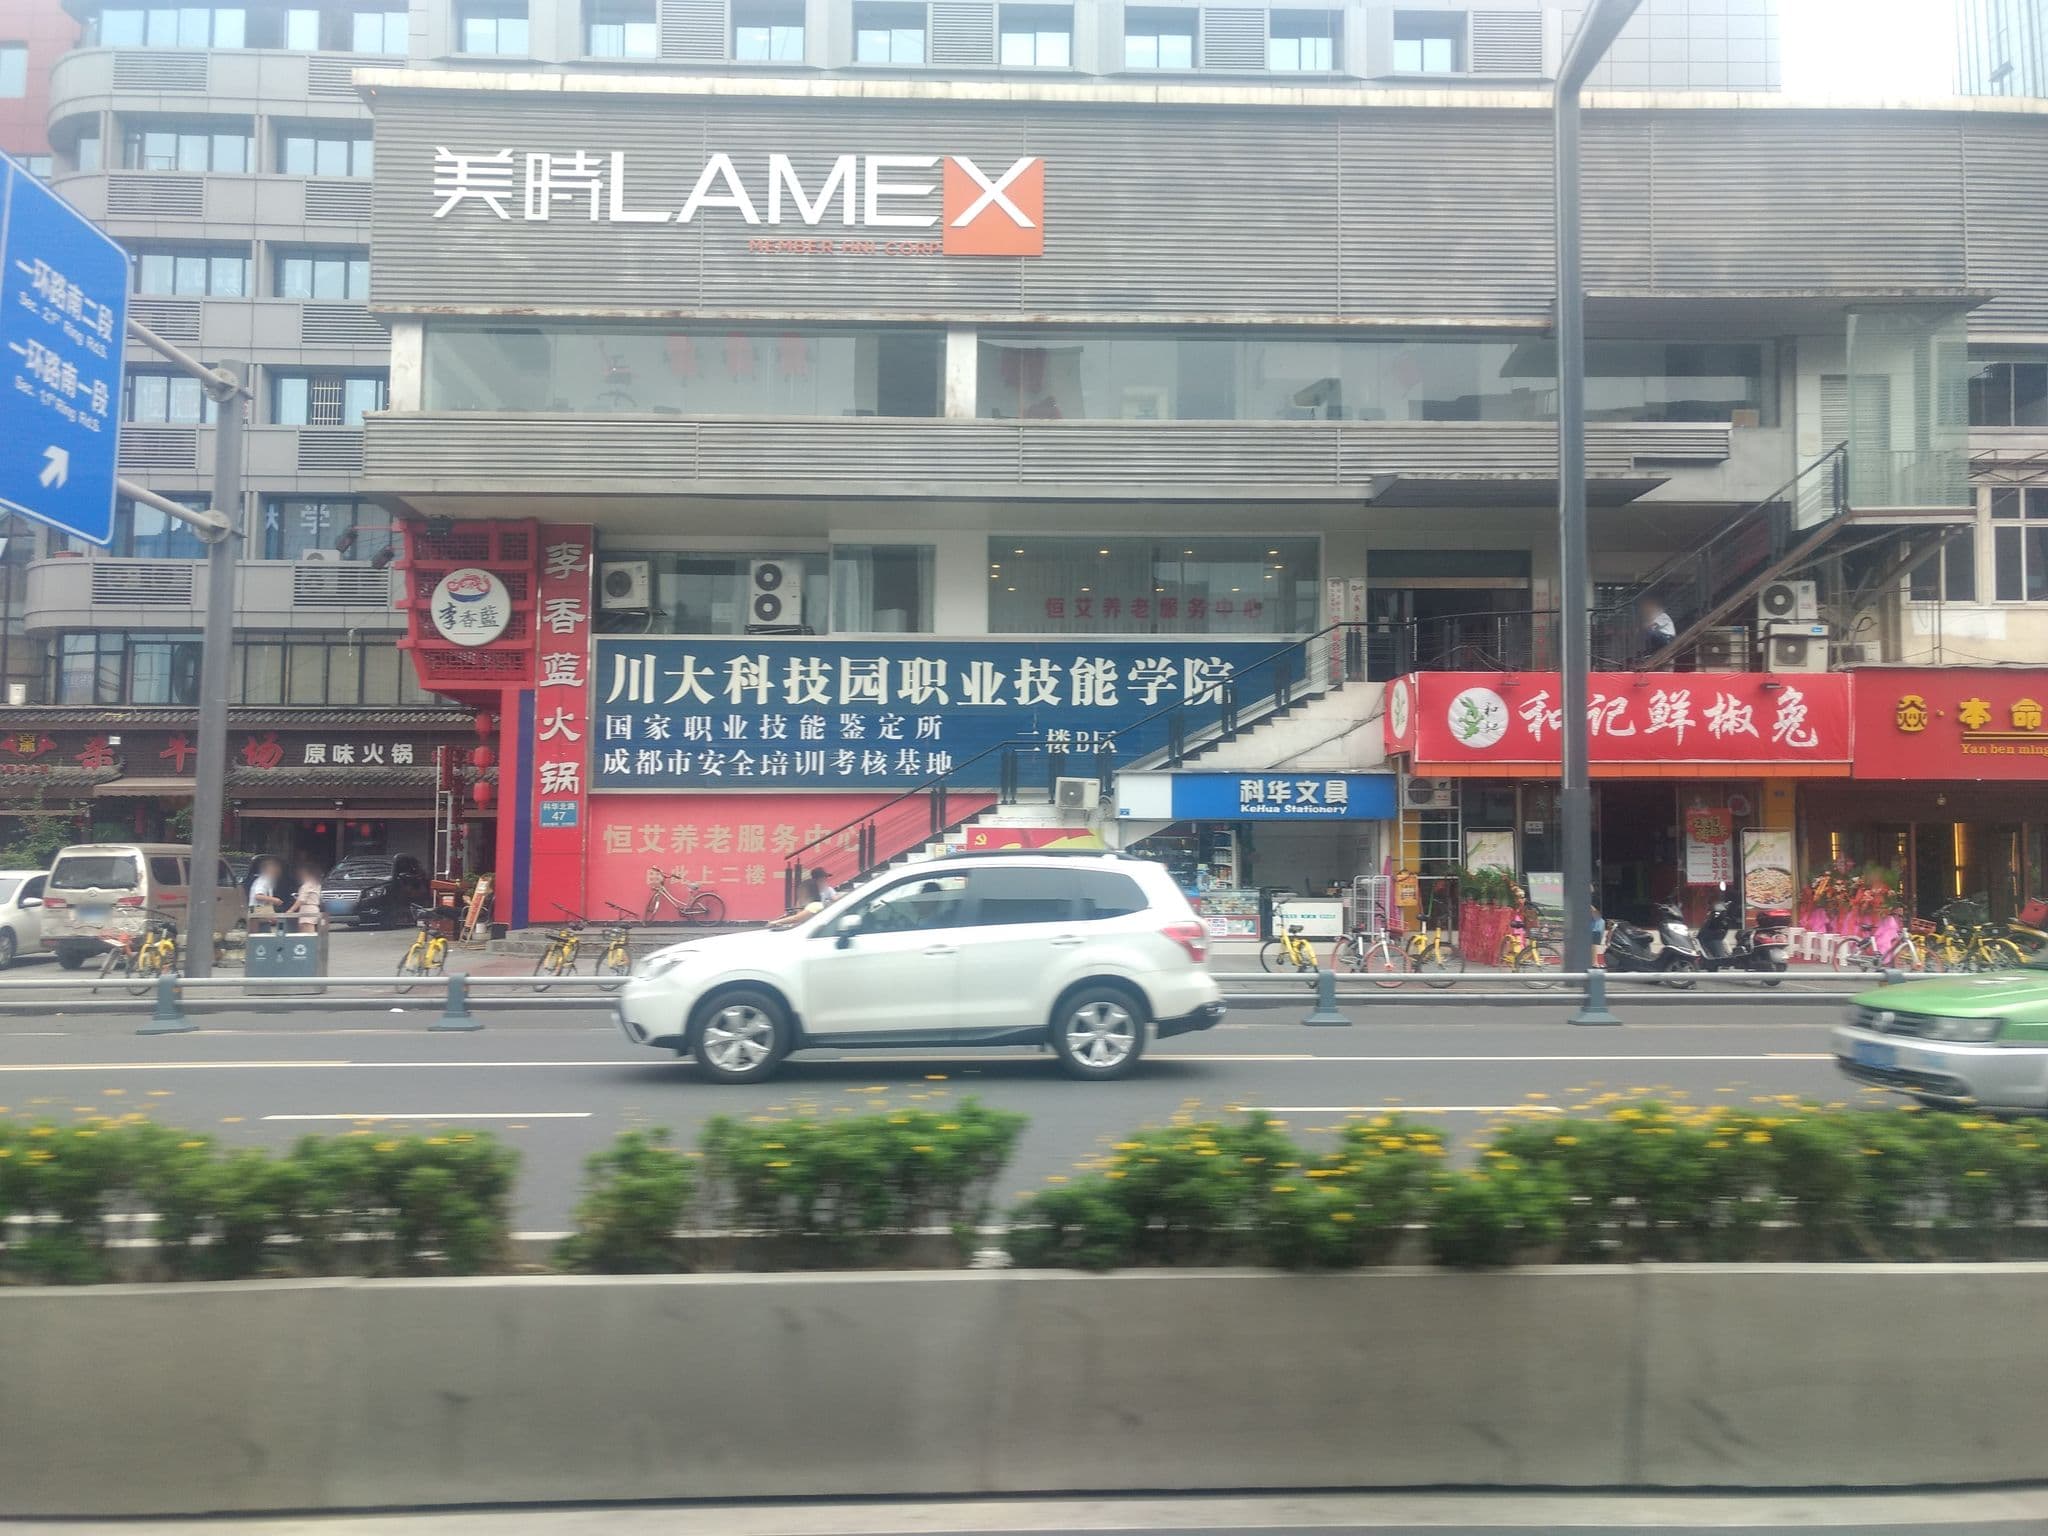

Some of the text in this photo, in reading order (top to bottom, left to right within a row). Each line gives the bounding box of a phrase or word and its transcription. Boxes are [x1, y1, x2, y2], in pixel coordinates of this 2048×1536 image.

[609, 151, 1036, 228] LAMEX
[749, 239, 833, 255] MEMBER
[16, 258, 114, 343] 一环路南二段
[8, 338, 109, 417] 一环路南一段
[1044, 597, 1264, 621] 恒艾养老服务中心
[539, 542, 587, 795] 李香蓝火锅
[605, 653, 1235, 706] 川大科技园职业技能学院
[604, 712, 943, 742] 国家职业技能鉴定所
[1518, 685, 1819, 748] 和记鲜椒兔
[303, 742, 414, 765] 原味火锅
[602, 747, 953, 776] 成都市安全培训考核基地
[1960, 743, 1987, 754] Yan
[1990, 743, 2015, 754] ben
[1240, 779, 1349, 804] 科华文具
[551, 811, 567, 821] 47
[1240, 804, 1348, 815] KeHua Stationery
[603, 824, 860, 855] 恒艾养老服务中心
